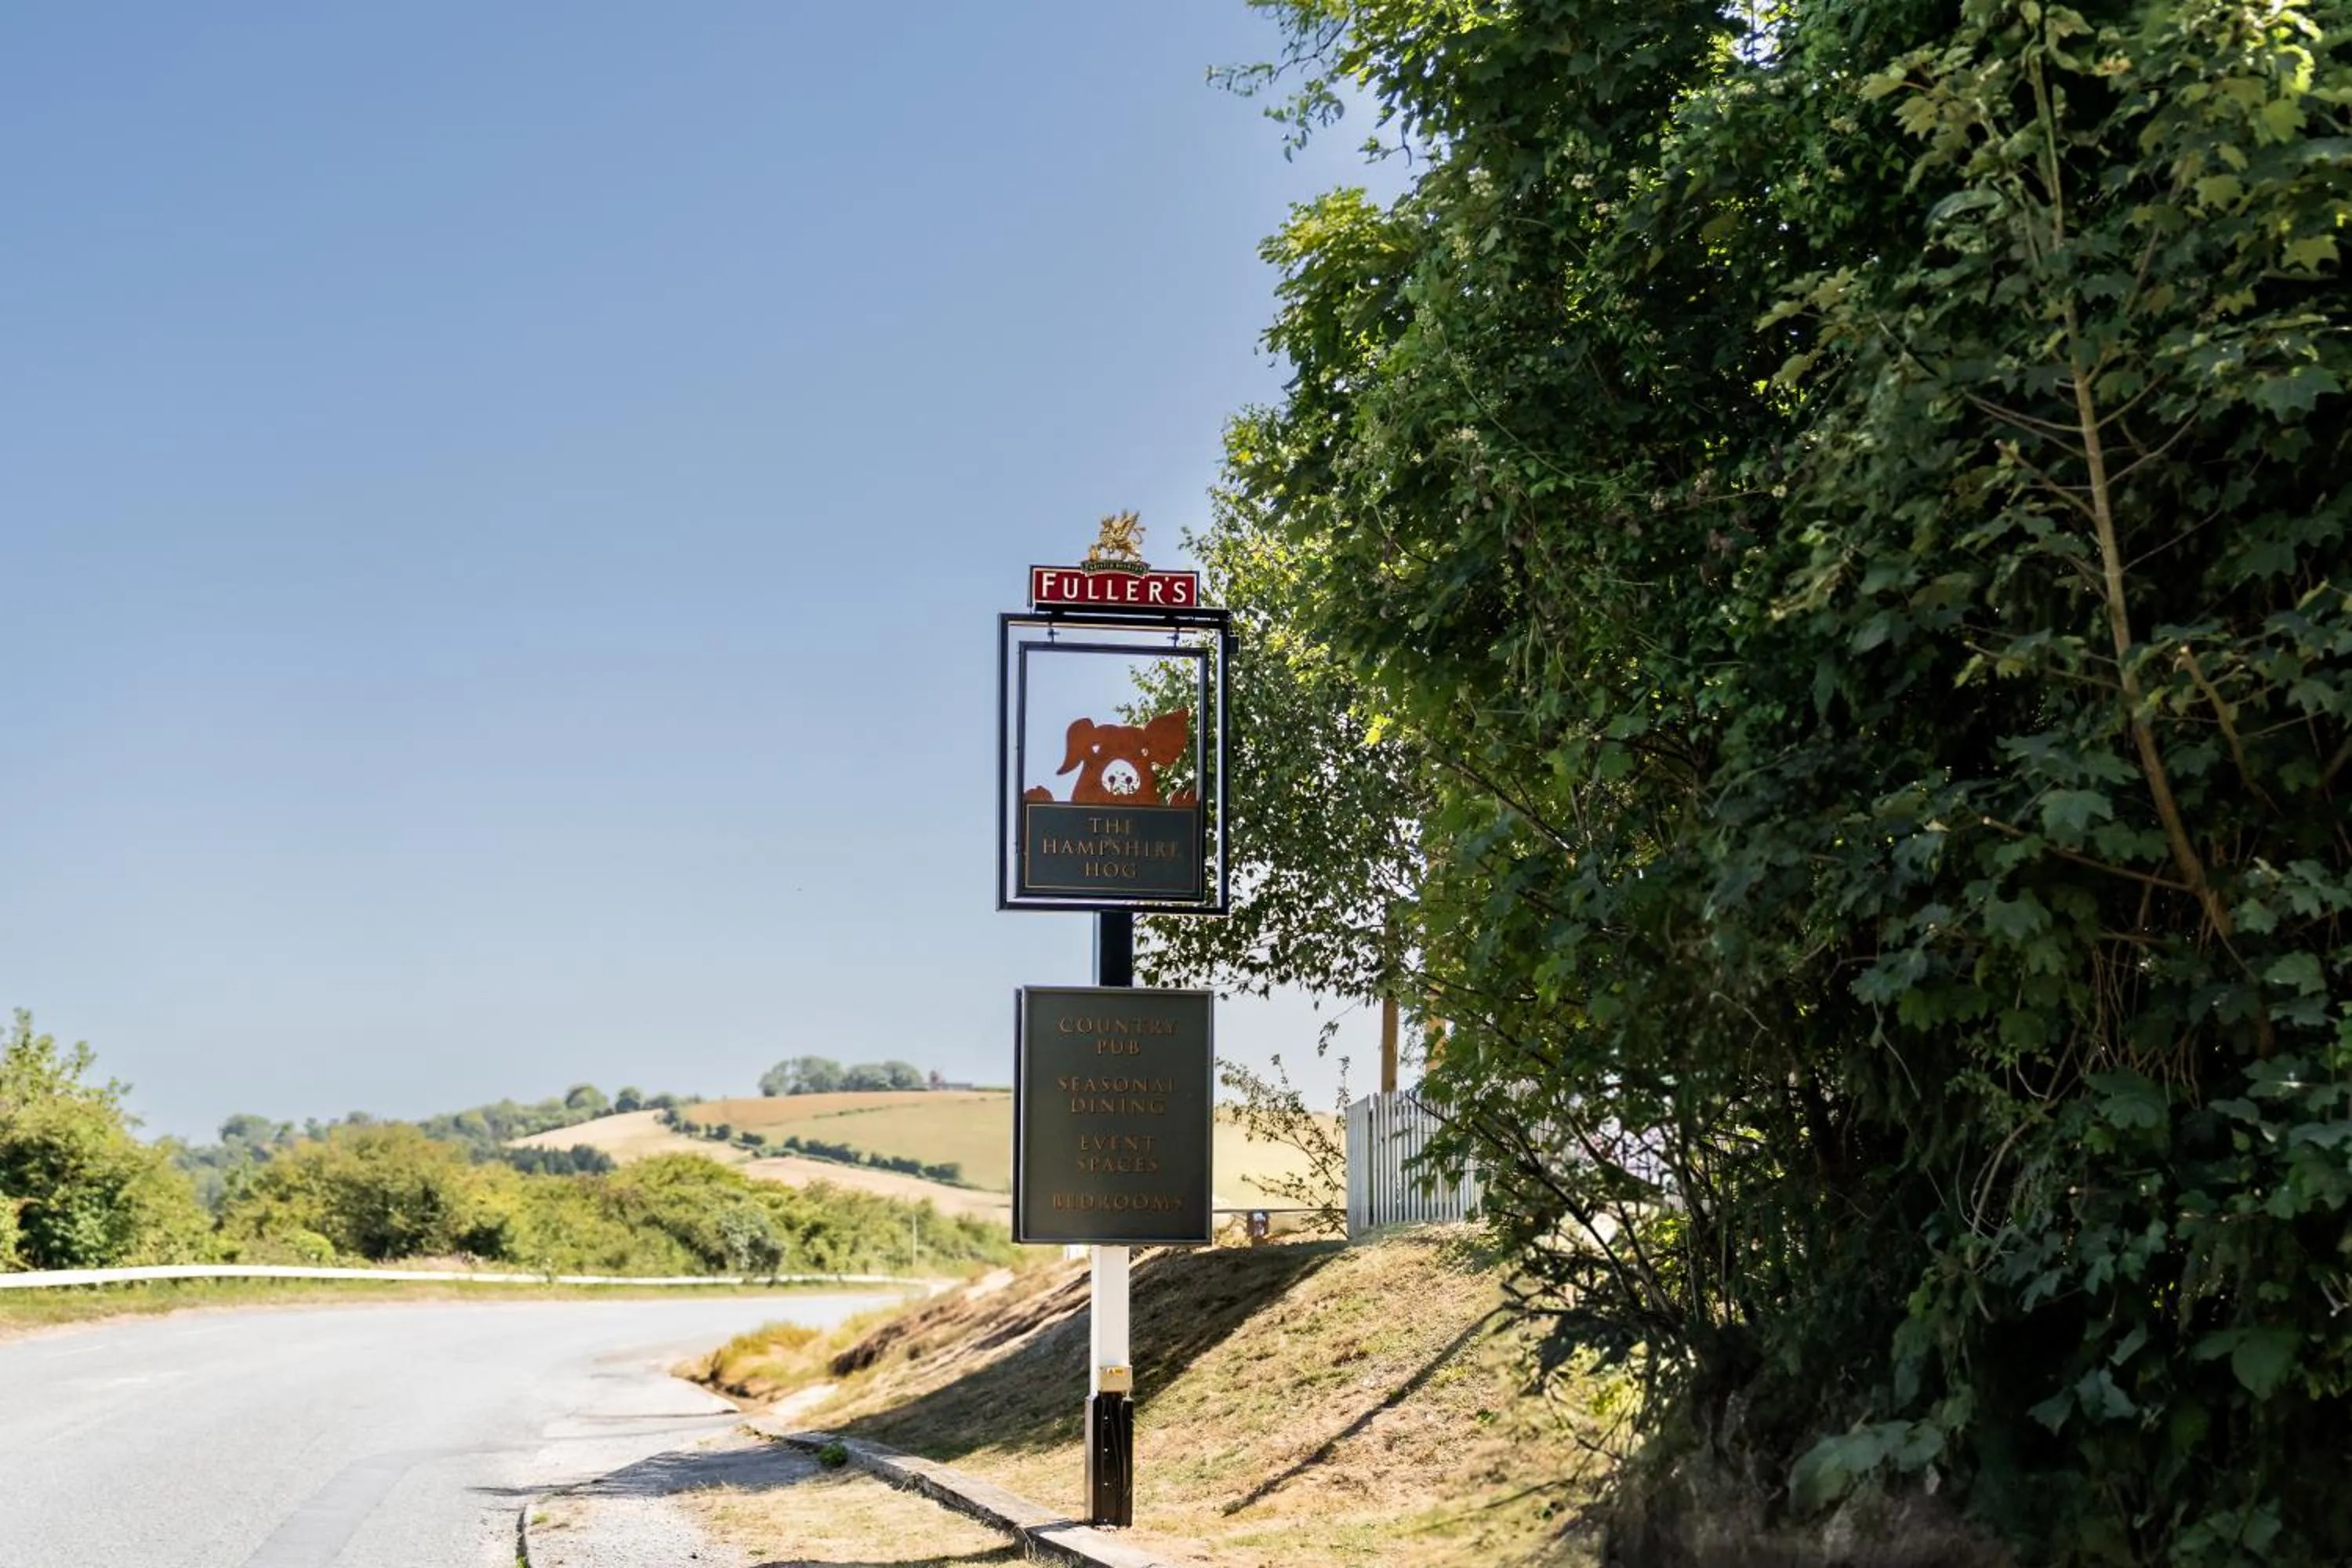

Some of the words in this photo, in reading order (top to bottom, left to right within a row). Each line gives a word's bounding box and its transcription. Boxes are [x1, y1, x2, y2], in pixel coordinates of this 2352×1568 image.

[1042, 572, 1187, 604] FULLER'S
[1042, 838, 1181, 857] HAMPSHIRE
[1085, 862, 1137, 878] HOG
[1059, 1017, 1179, 1035] COUNTRY
[1098, 1039, 1141, 1055] PUB
[1071, 1097, 1166, 1113] DINING
[1080, 1134, 1156, 1150] EVENT
[1077, 1156, 1159, 1172] SPACES
